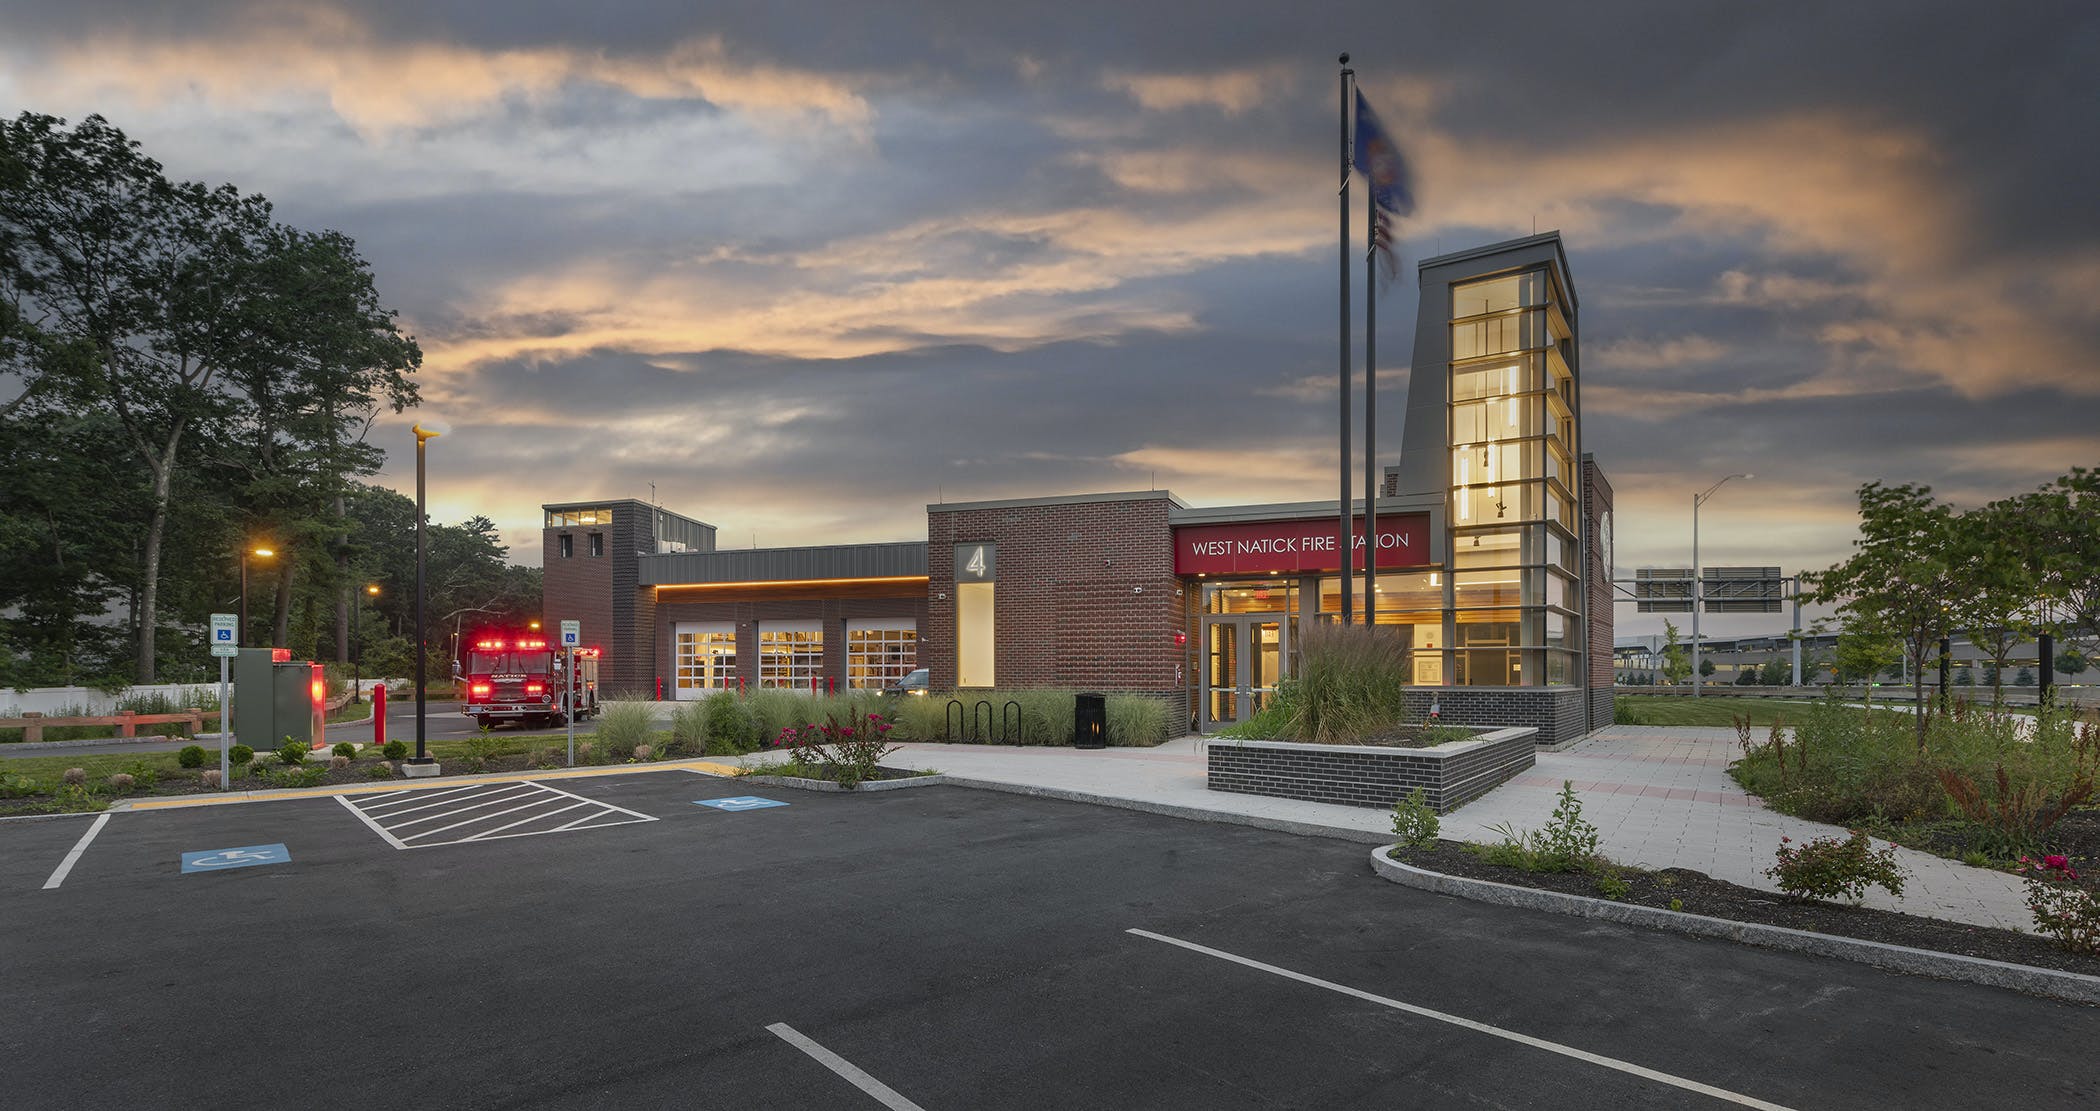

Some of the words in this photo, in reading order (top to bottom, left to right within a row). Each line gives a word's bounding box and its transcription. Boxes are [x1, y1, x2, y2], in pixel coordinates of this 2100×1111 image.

[1192, 540, 1233, 556] WEST
[1238, 537, 1297, 554] NATICK
[1302, 536, 1335, 552] FIRE
[1338, 533, 1409, 550] TAION
[965, 545, 987, 578] 4
